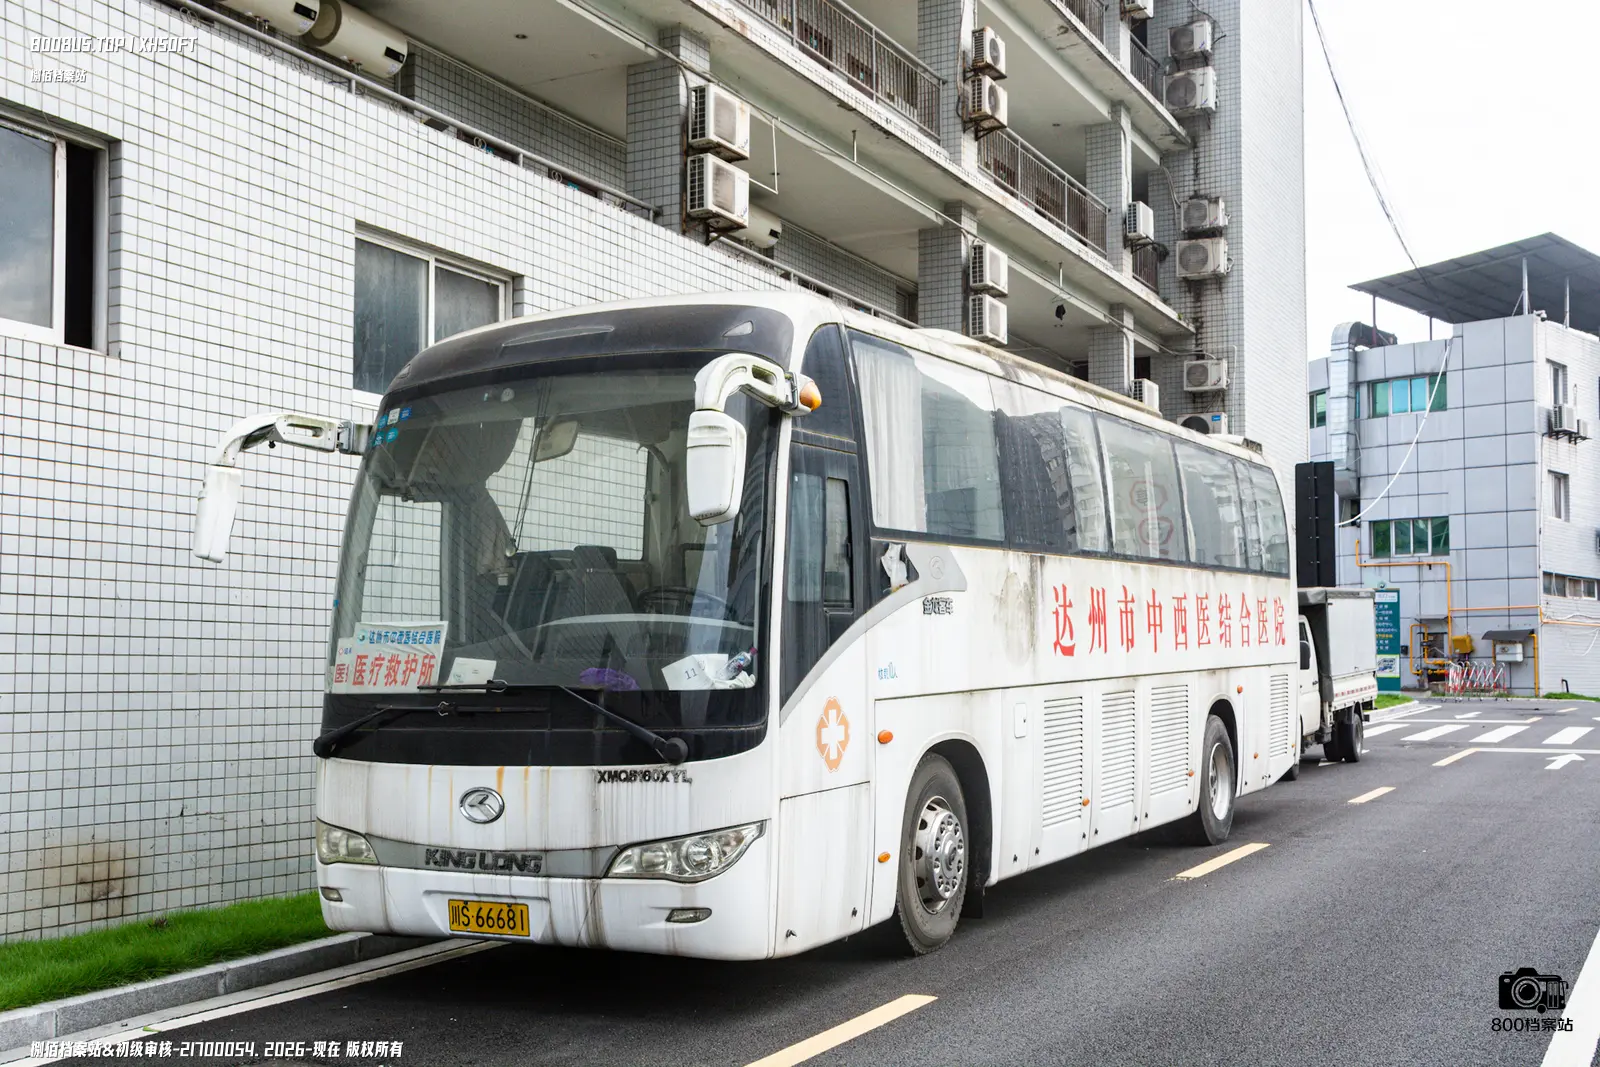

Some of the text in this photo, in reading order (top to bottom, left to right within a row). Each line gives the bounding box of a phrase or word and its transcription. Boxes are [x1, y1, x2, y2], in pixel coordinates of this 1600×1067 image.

[1052, 583, 1286, 657] 达州市中西医结合医院
[334, 663, 350, 683] 医
[352, 652, 437, 687] 医疗救护所
[684, 667, 698, 680] 11
[425, 848, 543, 873] KING LONG
